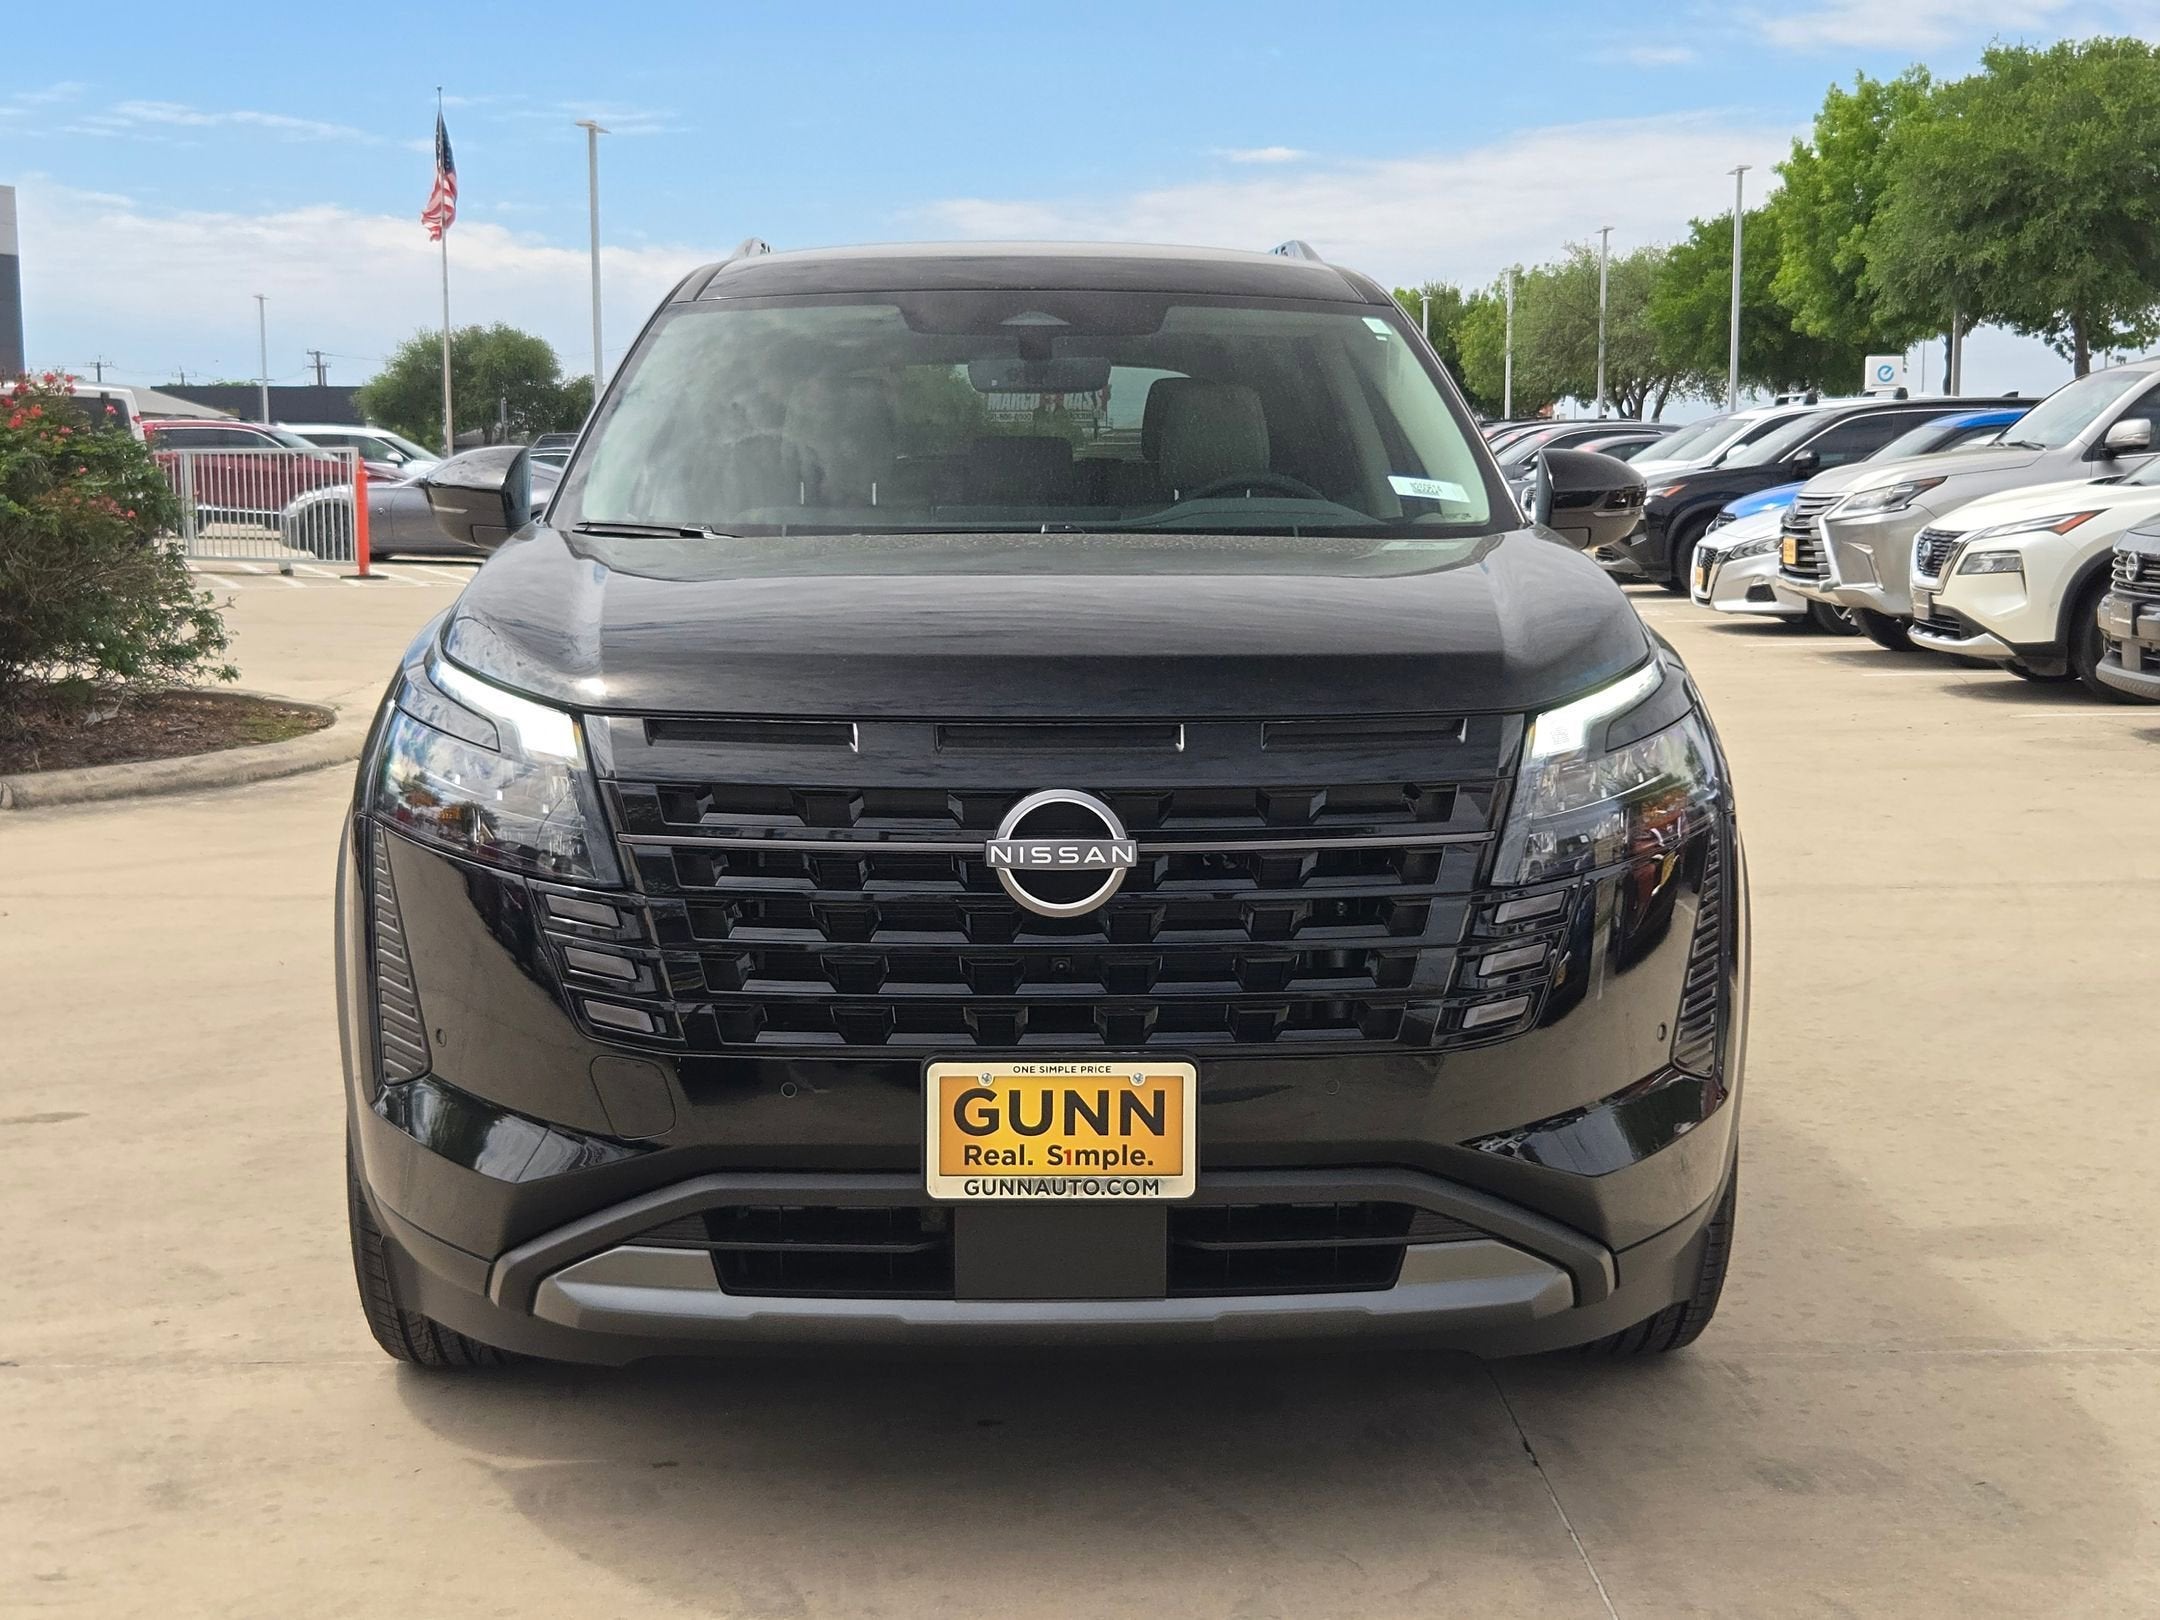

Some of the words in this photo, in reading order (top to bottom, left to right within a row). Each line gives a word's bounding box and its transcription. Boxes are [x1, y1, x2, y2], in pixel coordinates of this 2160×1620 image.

[990, 845, 1133, 864] NISSAN
[1013, 1065, 1036, 1074] ONE
[1039, 1065, 1077, 1074] SIMPLE
[1080, 1065, 1112, 1074] PRICE
[953, 1087, 1165, 1137] GUNN
[964, 1144, 1034, 1166] Real.
[963, 1178, 1159, 1196] GUNNAUTO.COM
